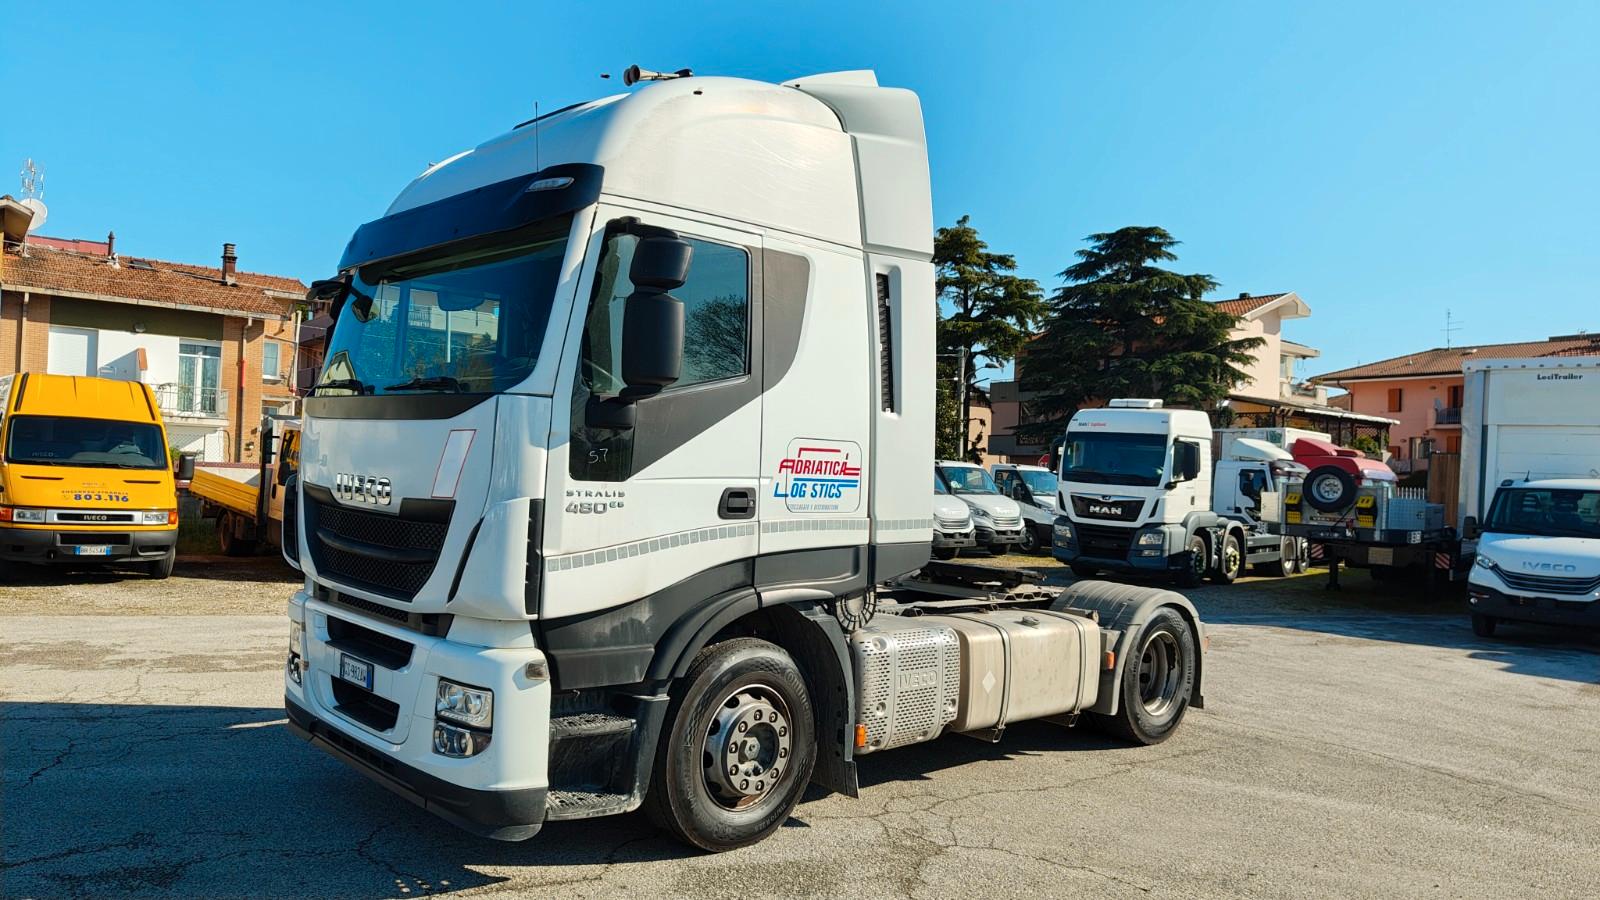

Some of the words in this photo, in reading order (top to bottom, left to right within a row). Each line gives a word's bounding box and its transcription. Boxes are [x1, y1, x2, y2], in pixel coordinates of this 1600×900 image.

[778, 458, 848, 476] ADRIATICA
[336, 473, 391, 505] IVECO
[73, 493, 129, 502] 803.116
[1089, 505, 1122, 515] MAN
[1522, 561, 1577, 573] IVECO
[898, 670, 937, 688] IVECO
